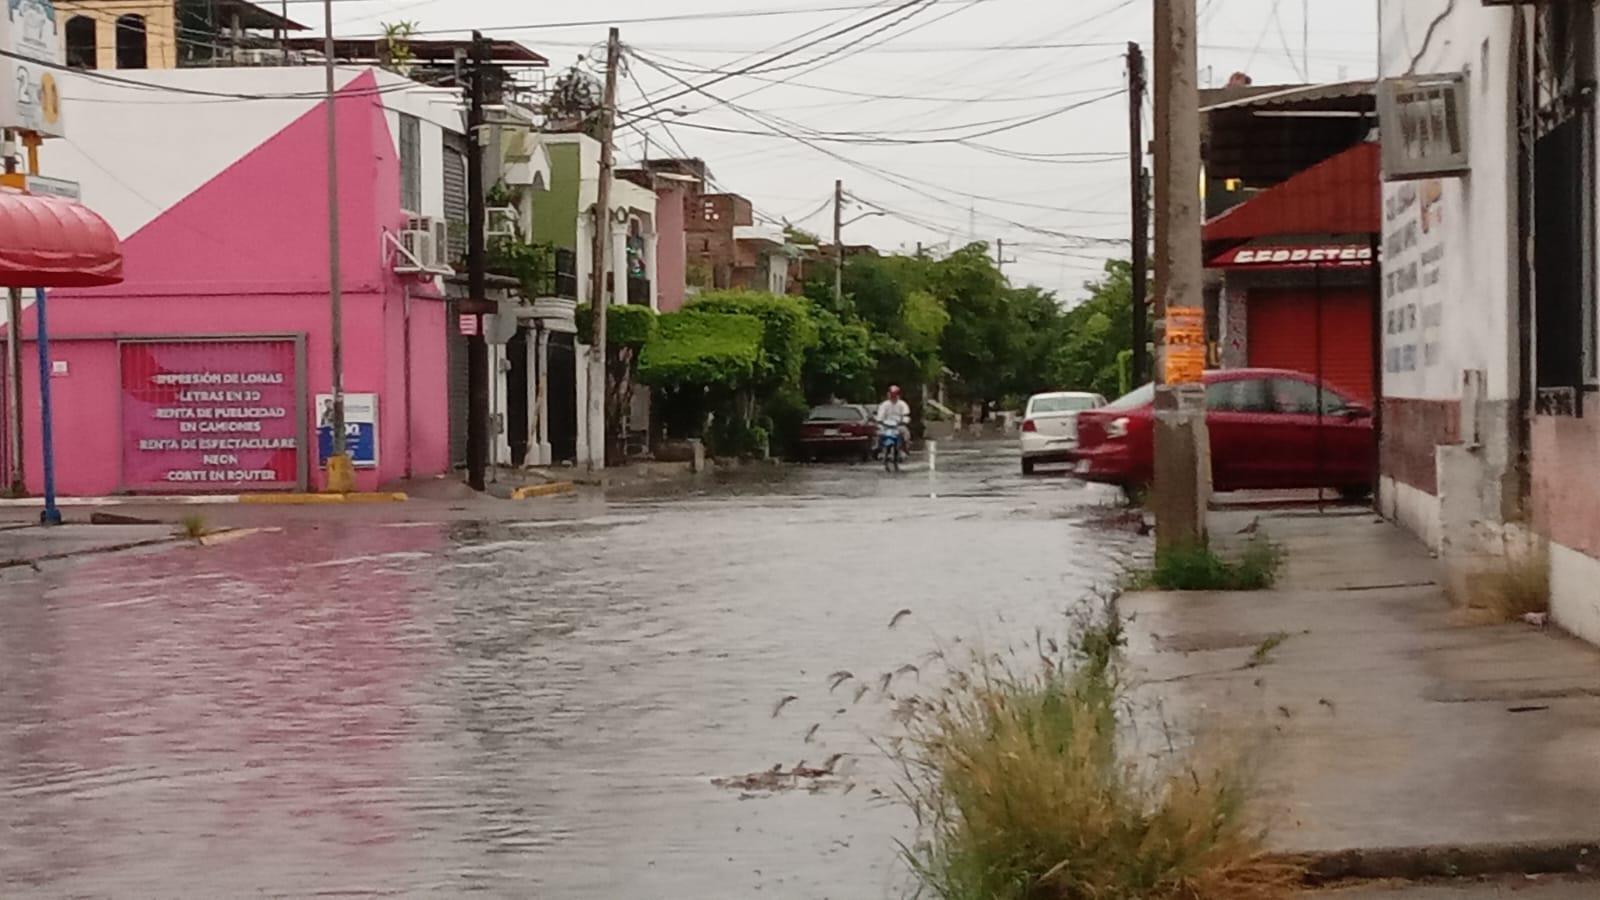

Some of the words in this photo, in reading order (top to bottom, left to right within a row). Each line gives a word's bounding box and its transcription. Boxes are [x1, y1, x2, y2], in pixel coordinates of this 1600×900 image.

[223, 373, 239, 384] DE
[179, 390, 223, 401] LETRAS
[226, 391, 242, 401] EN
[156, 408, 195, 418] RENTA
[197, 408, 213, 418] DE
[215, 408, 285, 418] PUBLICIDAD
[180, 421, 196, 432] EN
[199, 421, 261, 432] CAMIONES
[139, 439, 178, 449] RENTA
[181, 439, 196, 449] DE
[199, 439, 297, 449] ESPECTACULARE
[203, 455, 238, 465] NEON
[167, 471, 206, 481] CORTE
[209, 471, 225, 481] EN
[227, 471, 275, 481] ROUTER
